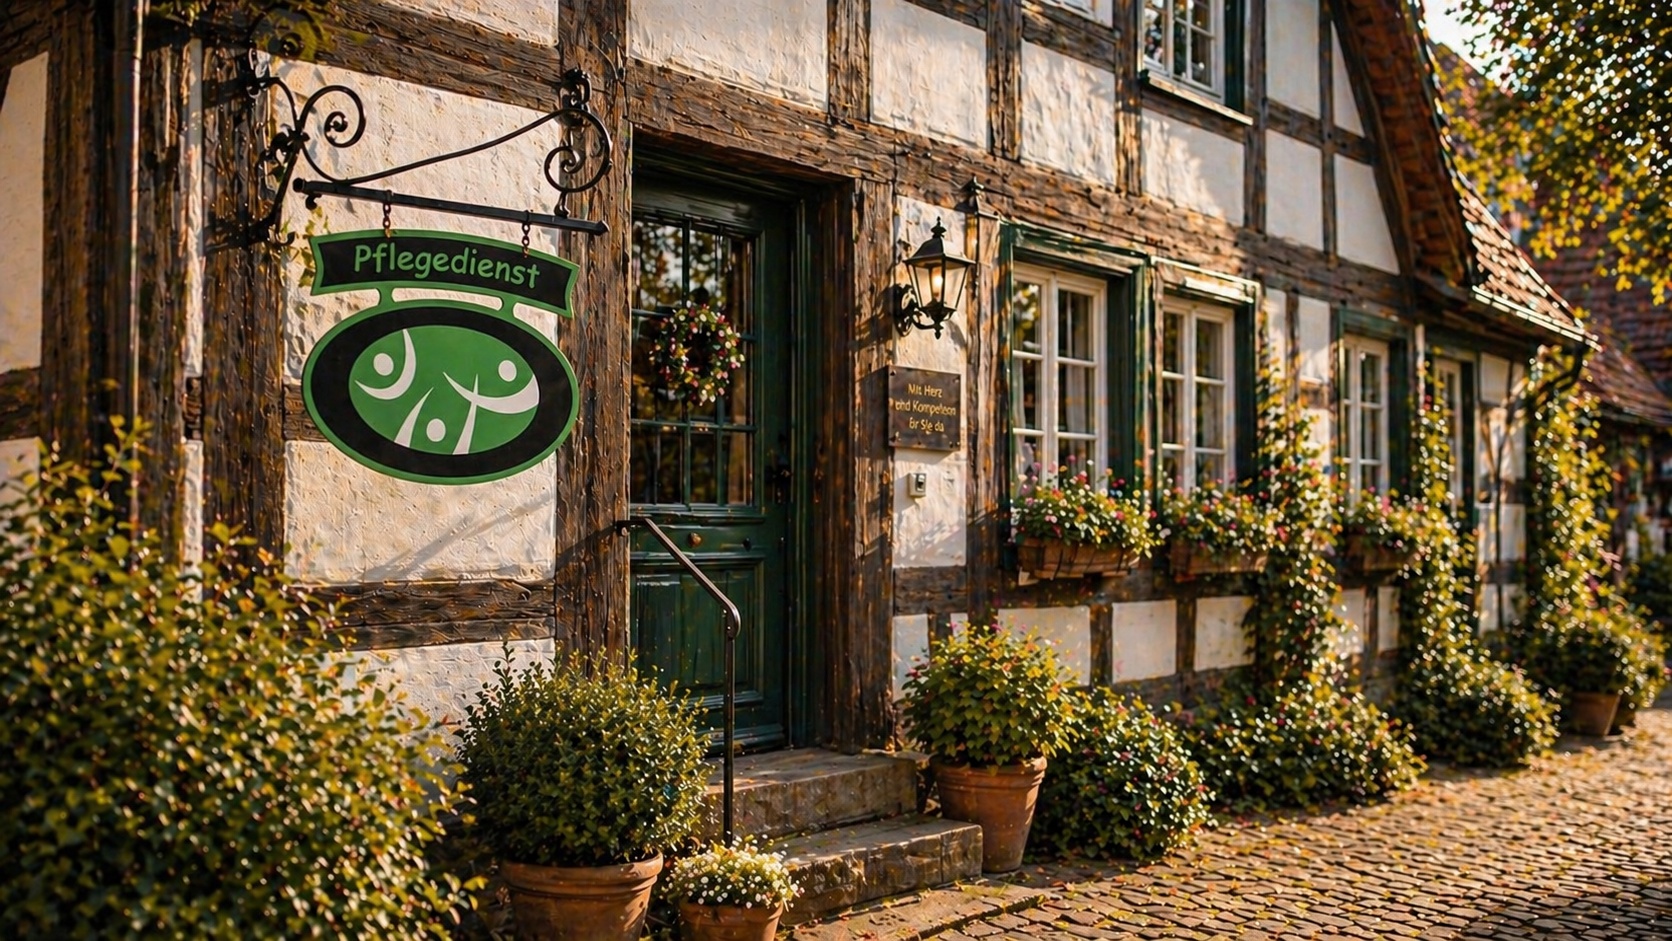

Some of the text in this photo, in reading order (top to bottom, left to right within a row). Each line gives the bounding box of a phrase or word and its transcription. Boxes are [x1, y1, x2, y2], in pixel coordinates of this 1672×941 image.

[354, 242, 541, 289] Pflegedienst
[924, 385, 942, 398] Herz
[934, 421, 944, 432] da
